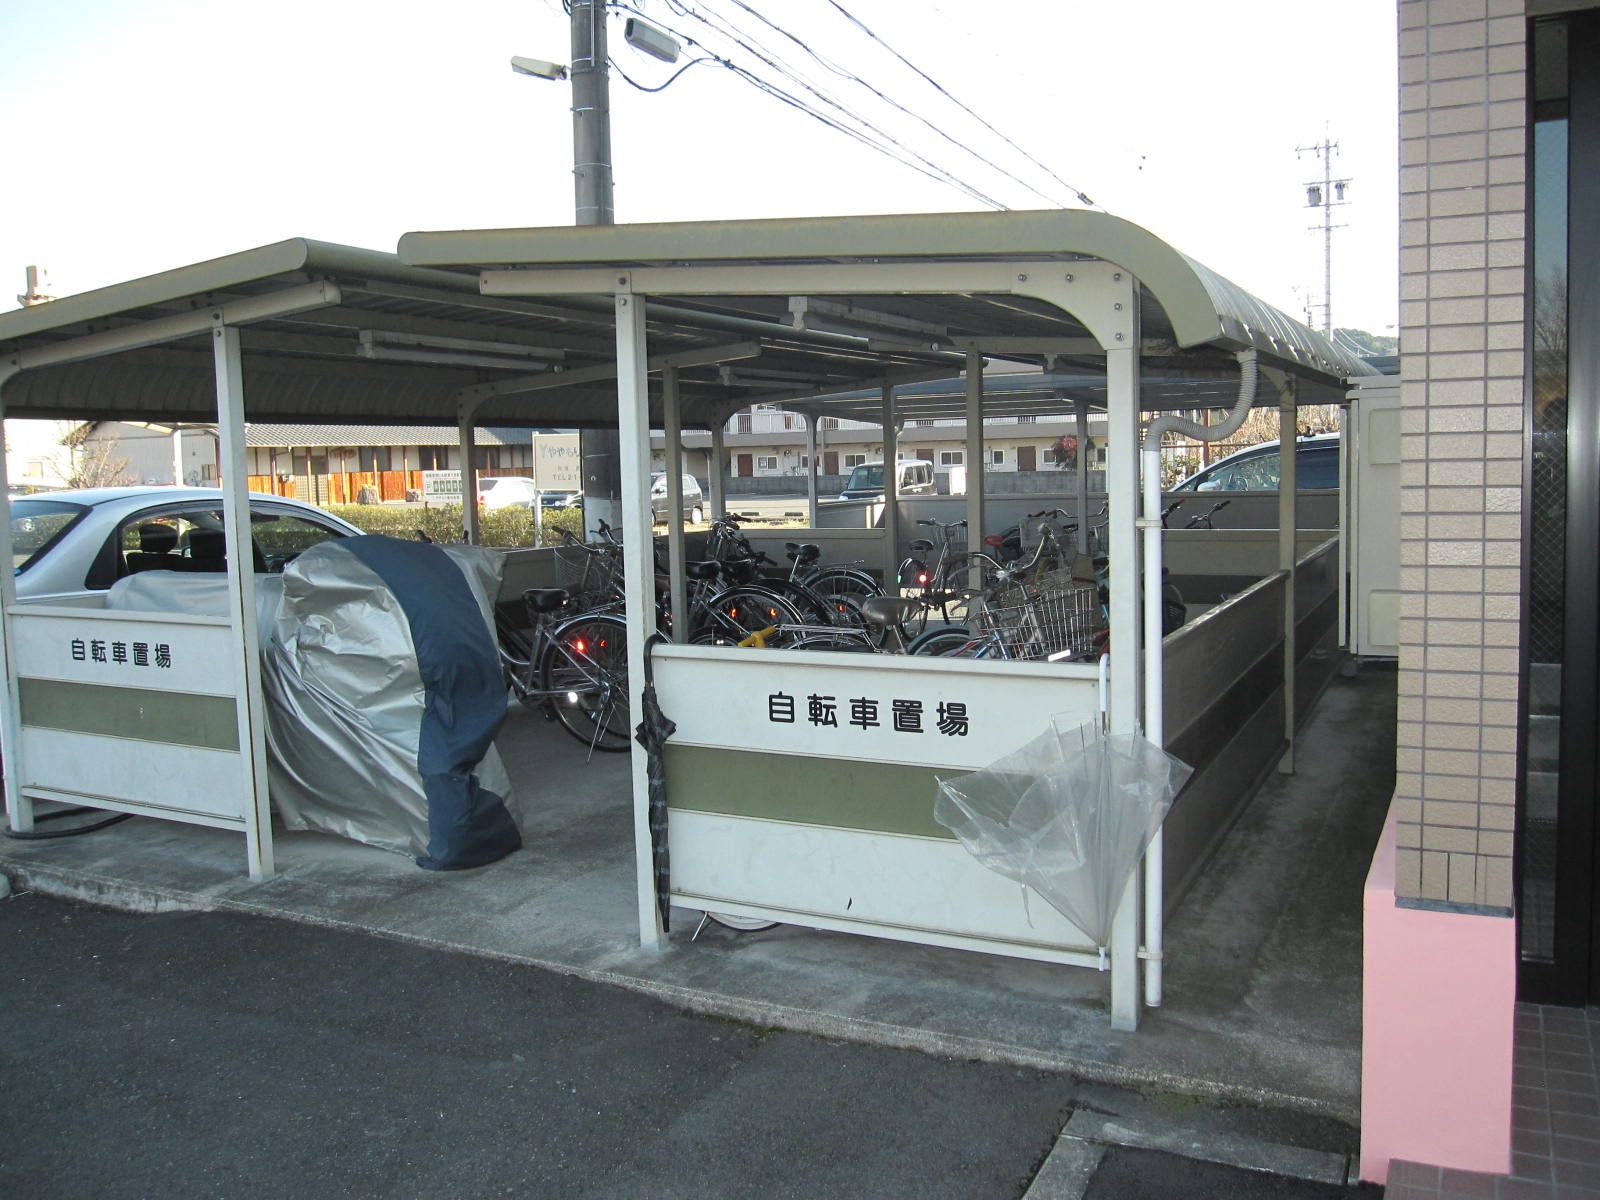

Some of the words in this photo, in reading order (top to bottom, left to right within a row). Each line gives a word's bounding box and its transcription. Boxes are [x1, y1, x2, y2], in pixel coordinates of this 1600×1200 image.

[71, 637, 172, 668] 自転車置場
[768, 690, 969, 736] 自転車置場
